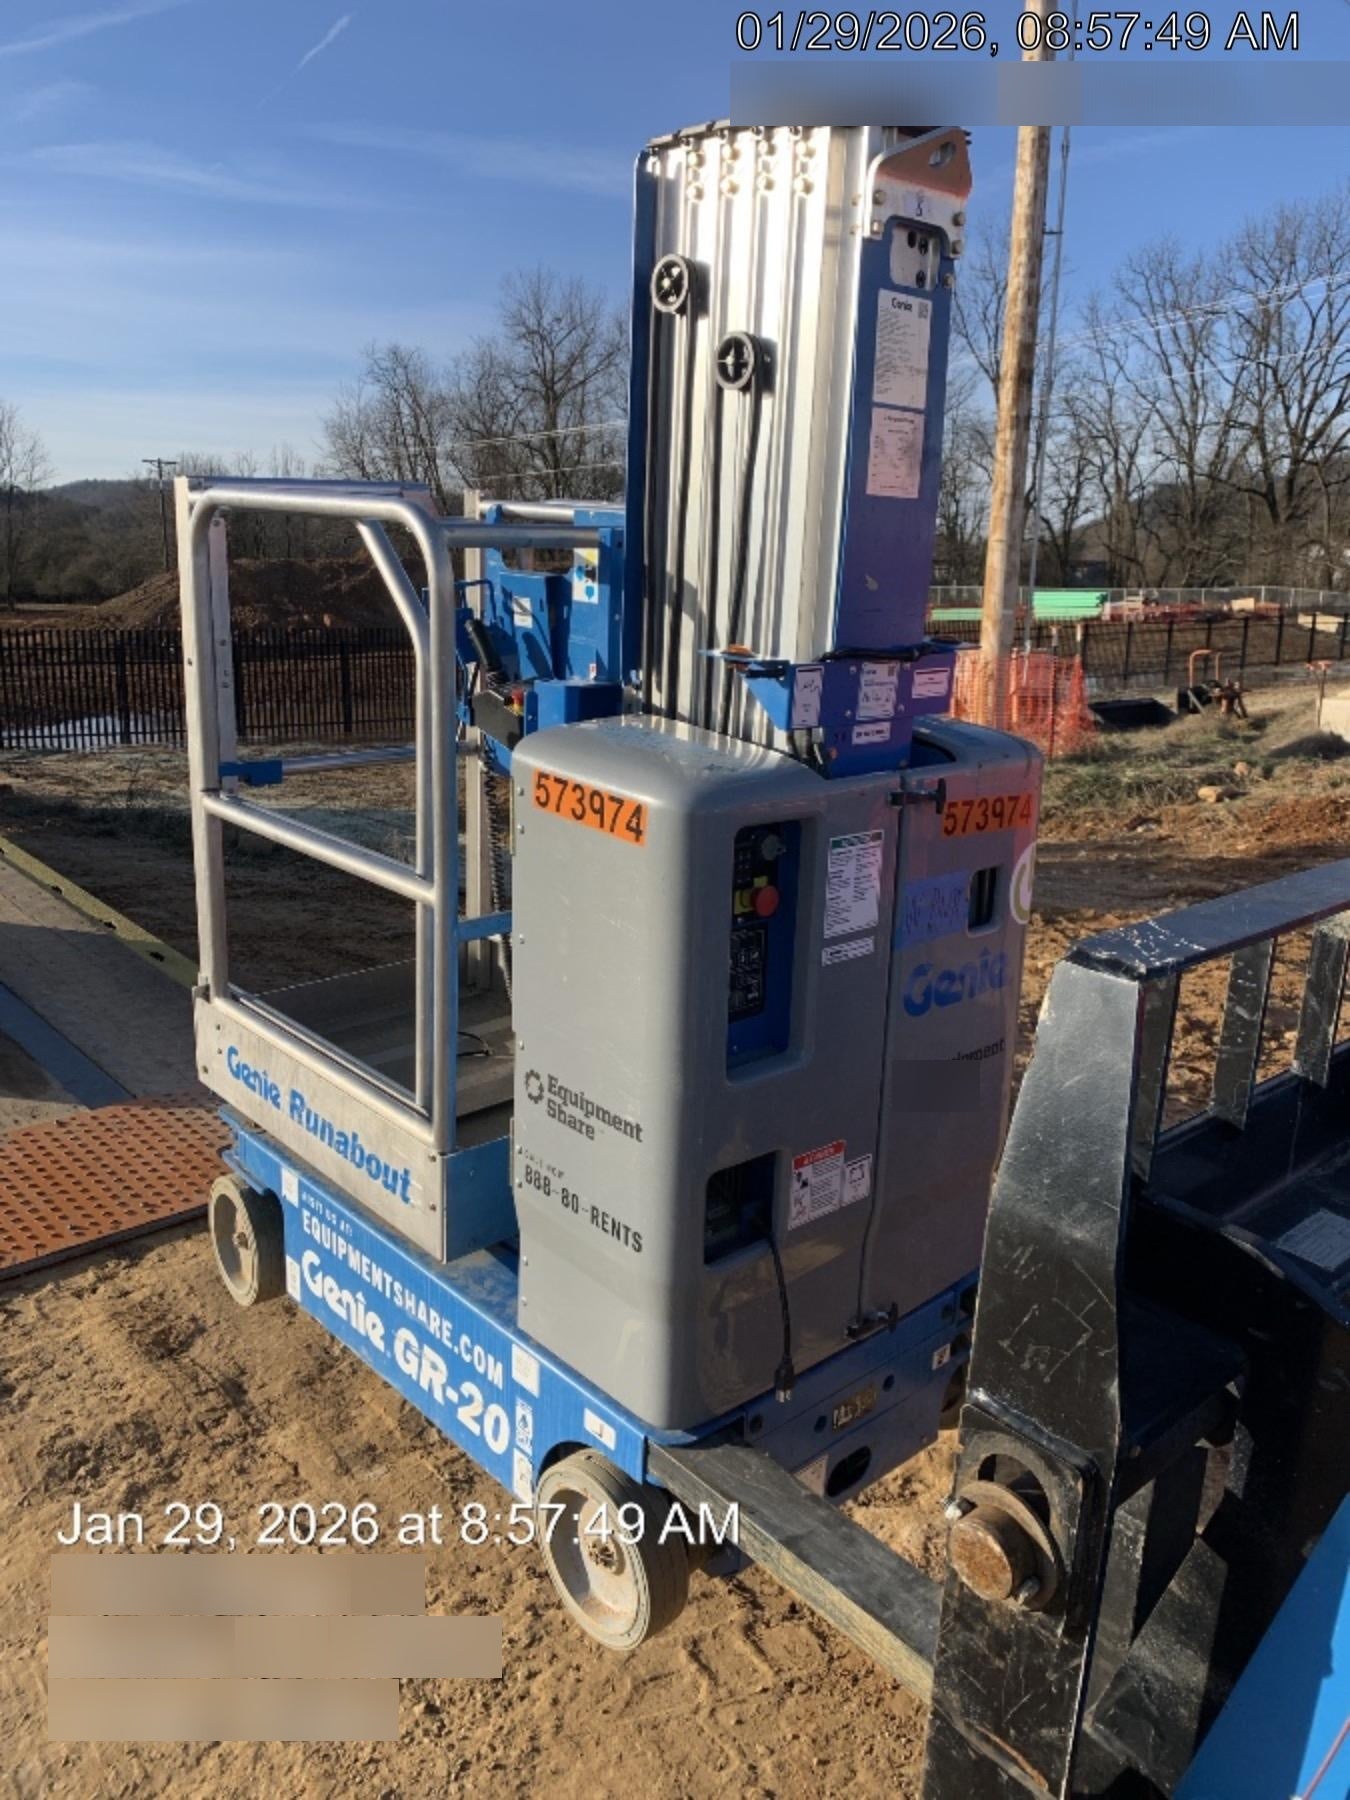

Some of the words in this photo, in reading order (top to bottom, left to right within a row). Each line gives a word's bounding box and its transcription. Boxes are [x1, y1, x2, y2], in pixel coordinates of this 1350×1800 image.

[535, 771, 644, 843] 573974
[943, 793, 1033, 836] 573974
[903, 947, 1008, 1017] Genie
[227, 1045, 282, 1110] Genie
[289, 1088, 412, 1205] Runabout
[547, 1073, 643, 1143] Equipment
[547, 1098, 595, 1140] Share
[525, 1164, 643, 1253] 888-80-RENTS
[302, 1208, 504, 1390] EQUIPMENTSHARE.COM
[301, 1249, 385, 1351] Genie
[394, 1327, 510, 1455] GR-20
